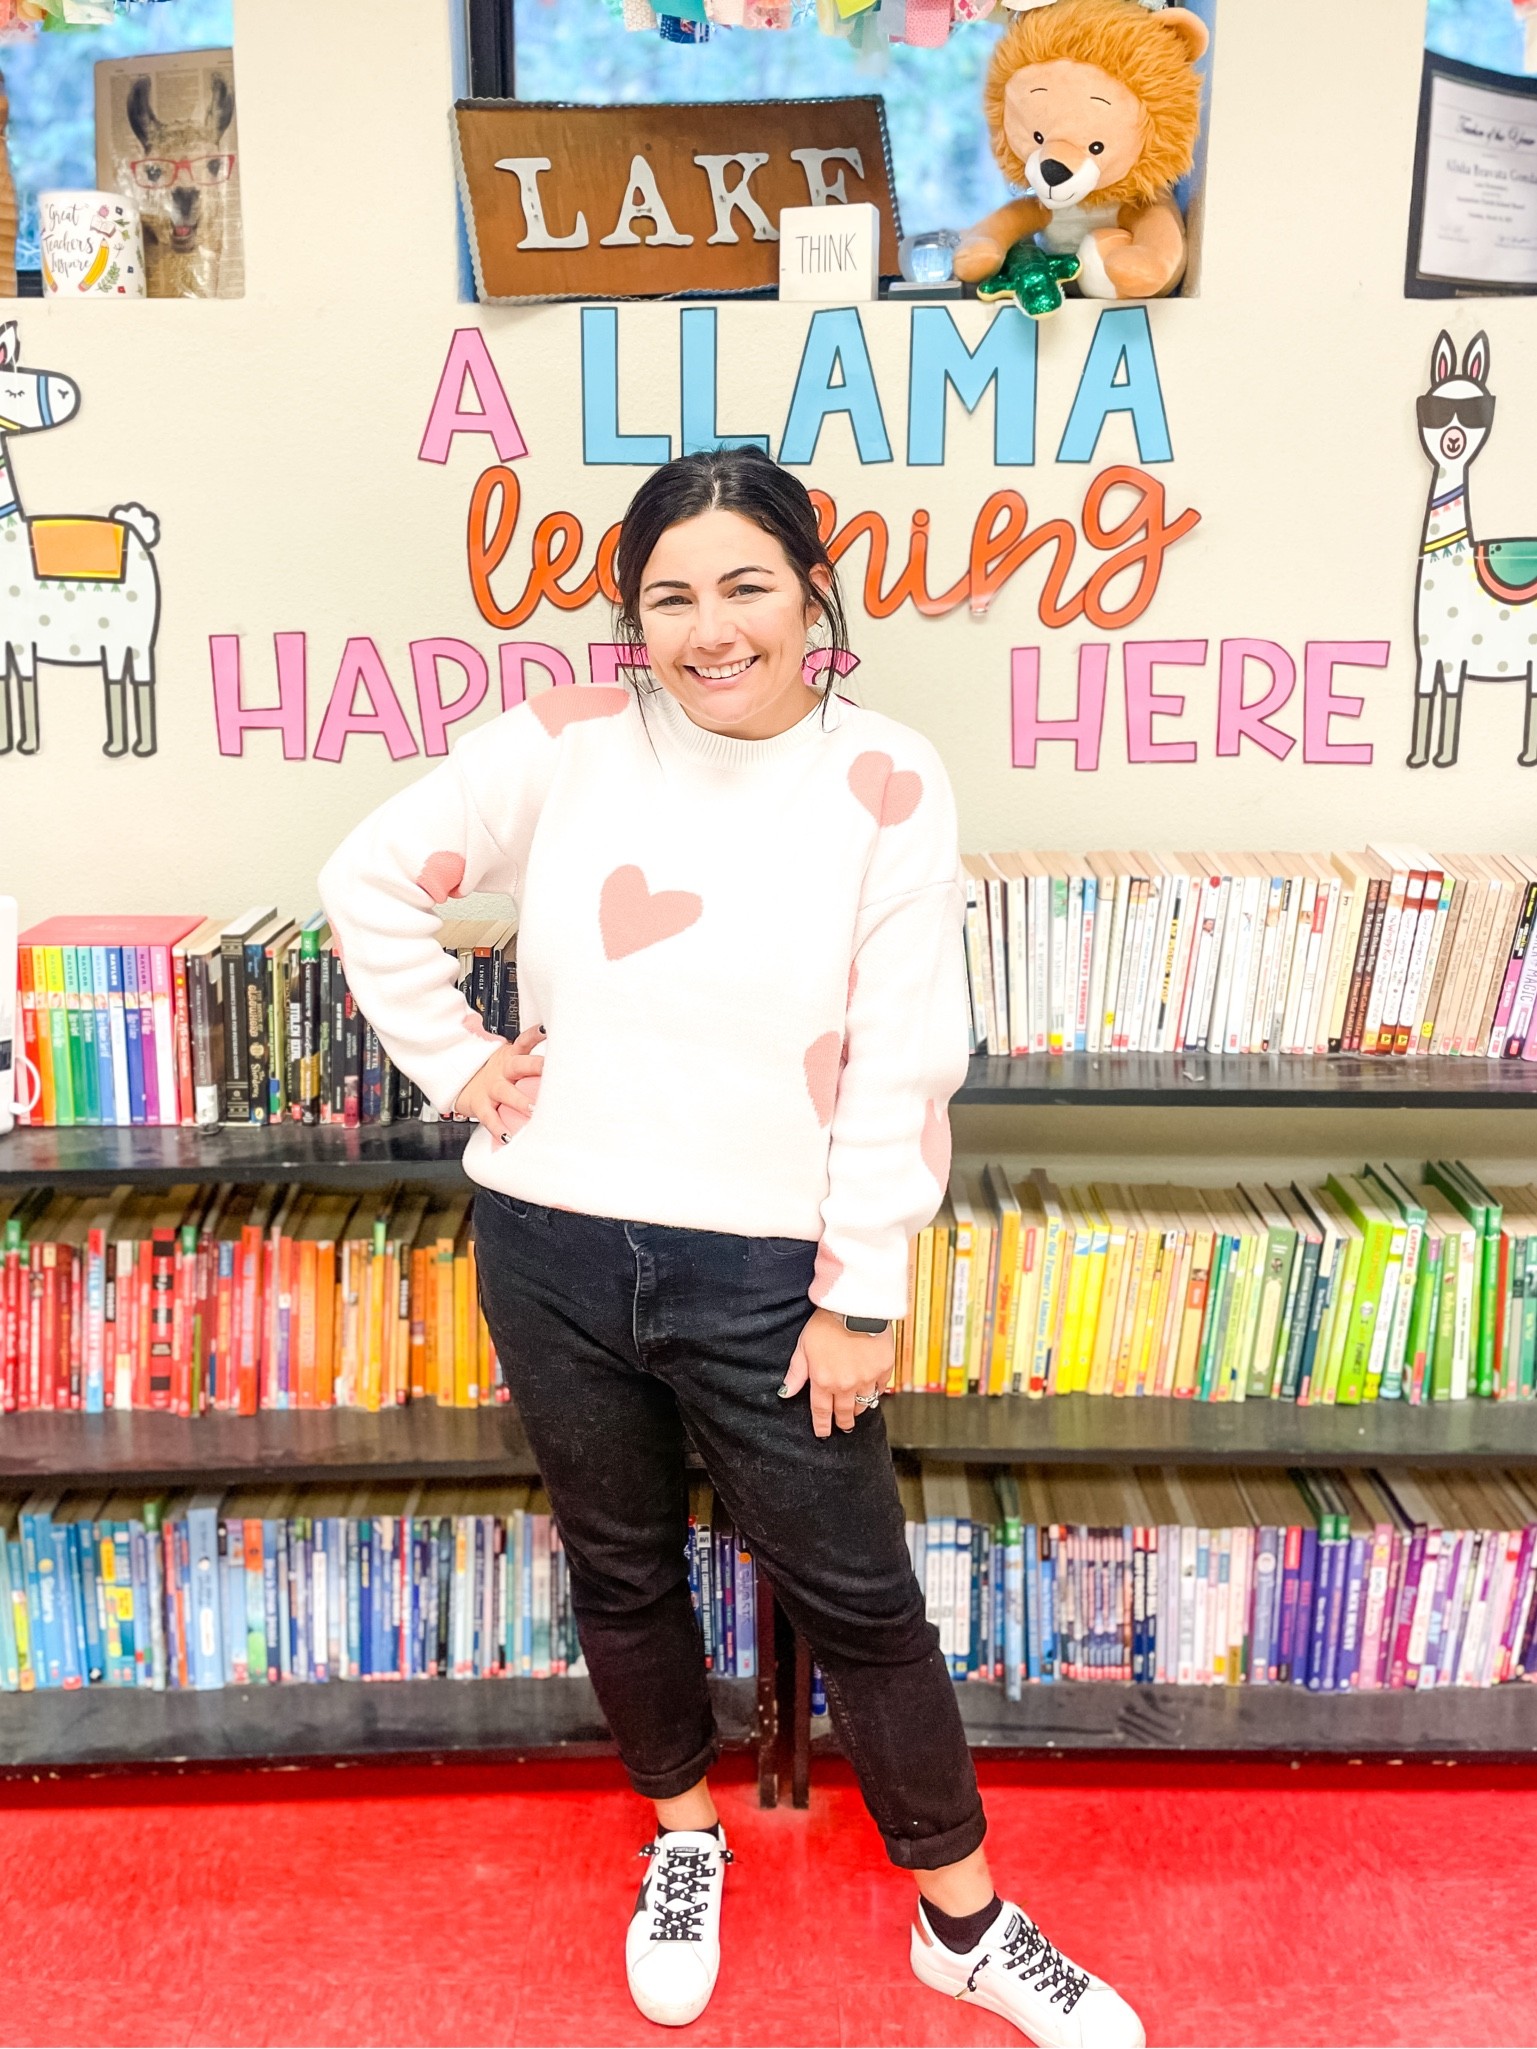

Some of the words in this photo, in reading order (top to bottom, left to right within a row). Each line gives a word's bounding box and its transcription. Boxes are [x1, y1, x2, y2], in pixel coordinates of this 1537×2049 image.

[48, 203, 82, 232] Great
[42, 231, 94, 255] Teachers
[795, 232, 859, 274] THINK
[51, 252, 88, 278] Inspire
[417, 327, 531, 465] A
[580, 306, 1175, 466] LLAMA
[467, 463, 1202, 631] lening
[208, 632, 861, 763] HAPP
[1010, 639, 1391, 771] HERE
[1085, 918, 1093, 933] MR.
[1384, 924, 1396, 948] Wimpy
[1081, 936, 1091, 977] POPPER'S
[1359, 937, 1369, 956] Dickens
[1370, 936, 1380, 955] Dickens
[1382, 948, 1393, 961] Kid
[66, 954, 74, 986] NAYLOR
[80, 954, 88, 987] NAYLOR
[109, 953, 117, 986] NAYLOR
[126, 953, 134, 986] NAYLOR
[139, 953, 147, 985] NAYLOR
[155, 953, 163, 986] NAYLOR
[1519, 968, 1537, 1002] MAGIC
[504, 990, 519, 1029] HOBBIT
[1077, 980, 1088, 1025] PENGUINS
[1048, 1223, 1060, 1239] The
[1047, 1241, 1058, 1256] Old
[1447, 1237, 1458, 1267] CREECH
[1042, 1259, 1056, 1298] Farmer's
[1037, 1300, 1051, 1337] Almanac
[1036, 1339, 1046, 1353] for
[1033, 1355, 1045, 1375] Kids
[1348, 1578, 1362, 1611] BLACK
[1343, 1612, 1358, 1651] BEAUTY
